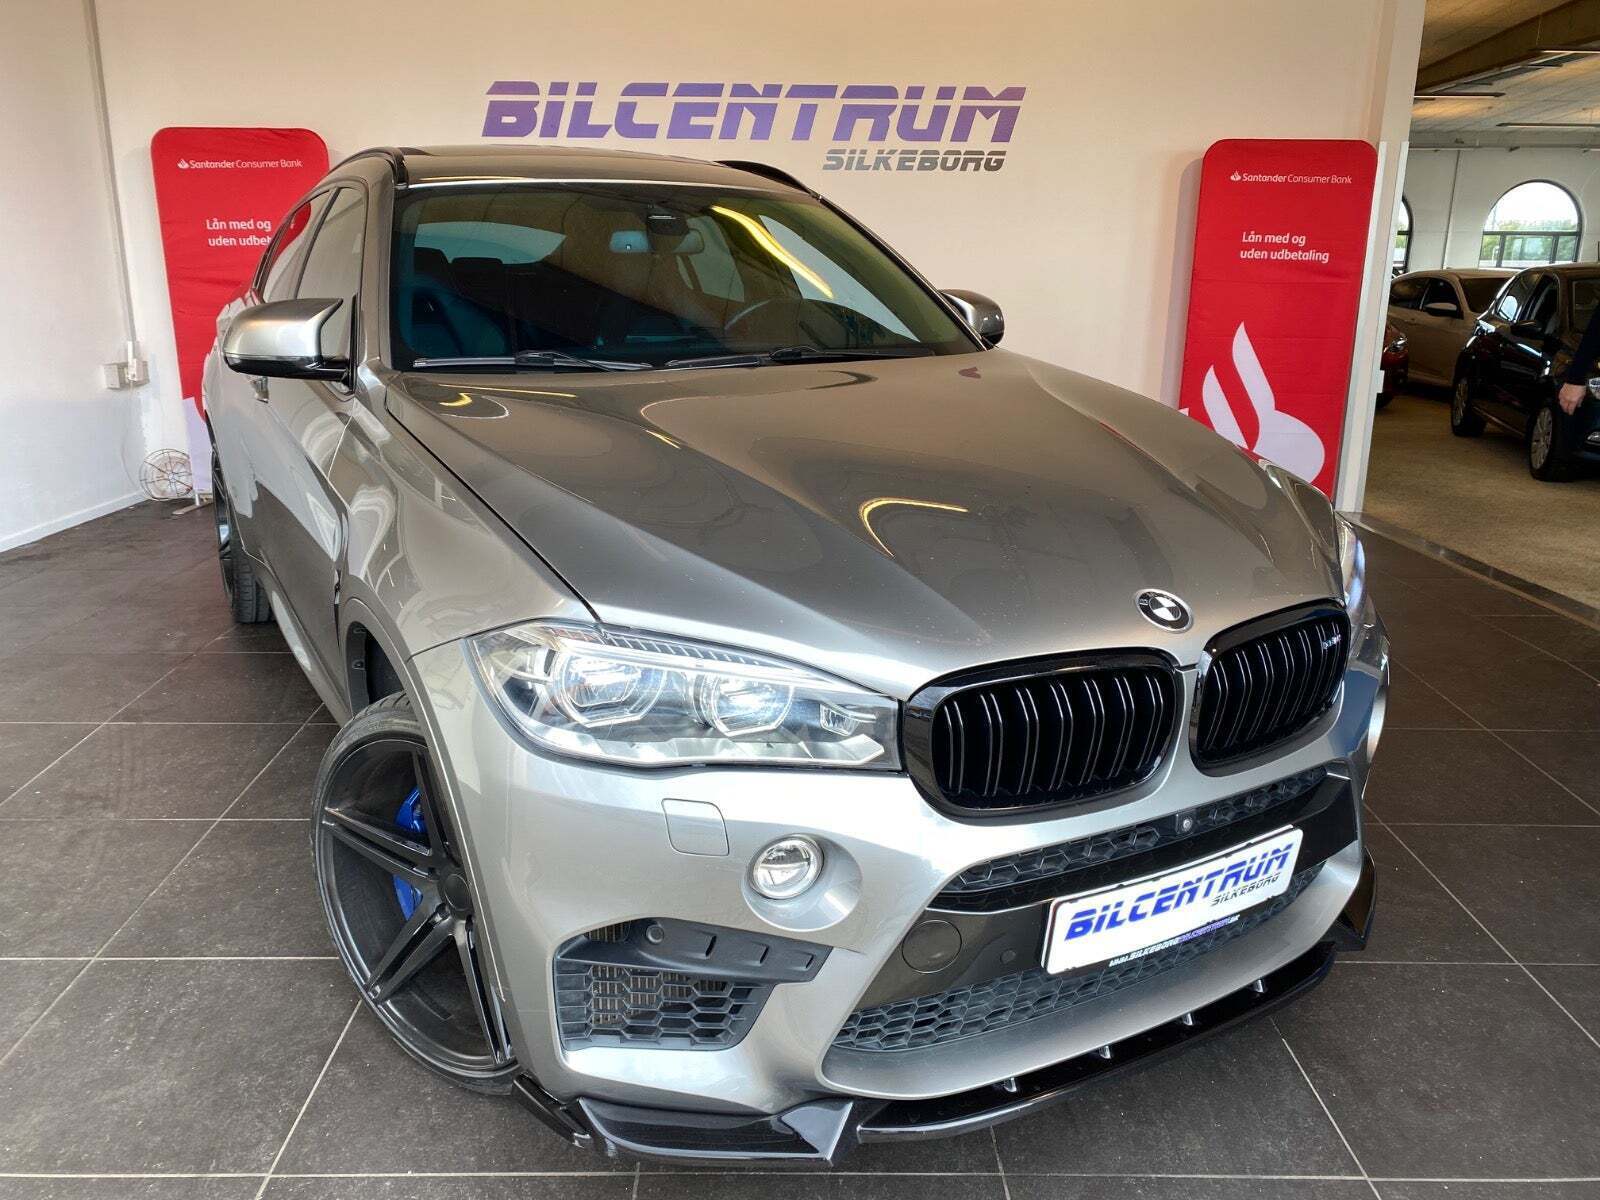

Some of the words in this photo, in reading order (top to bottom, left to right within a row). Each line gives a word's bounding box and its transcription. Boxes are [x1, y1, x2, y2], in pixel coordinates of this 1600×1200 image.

[481, 80, 1027, 143] BILCENTRUM
[190, 159, 235, 169] Santander
[236, 159, 279, 168] Consumer
[280, 159, 303, 168] Bank
[822, 148, 1008, 172] SILKEBORG
[1242, 173, 1287, 183] Santander
[1287, 174, 1330, 184] Consumer
[1330, 174, 1353, 184] Bank
[206, 217, 227, 230] Lån
[229, 218, 254, 230] med
[257, 220, 271, 232] og
[208, 235, 236, 246] uden
[239, 235, 272, 246] udbet
[1242, 230, 1262, 243] Lån
[1264, 232, 1290, 244] med
[1291, 234, 1307, 246] og
[1240, 248, 1268, 259] uden
[1270, 249, 1329, 264] udbetaling
[1064, 843, 1294, 941] BILCENTRUM
[1210, 872, 1282, 907] SILKEBORG
